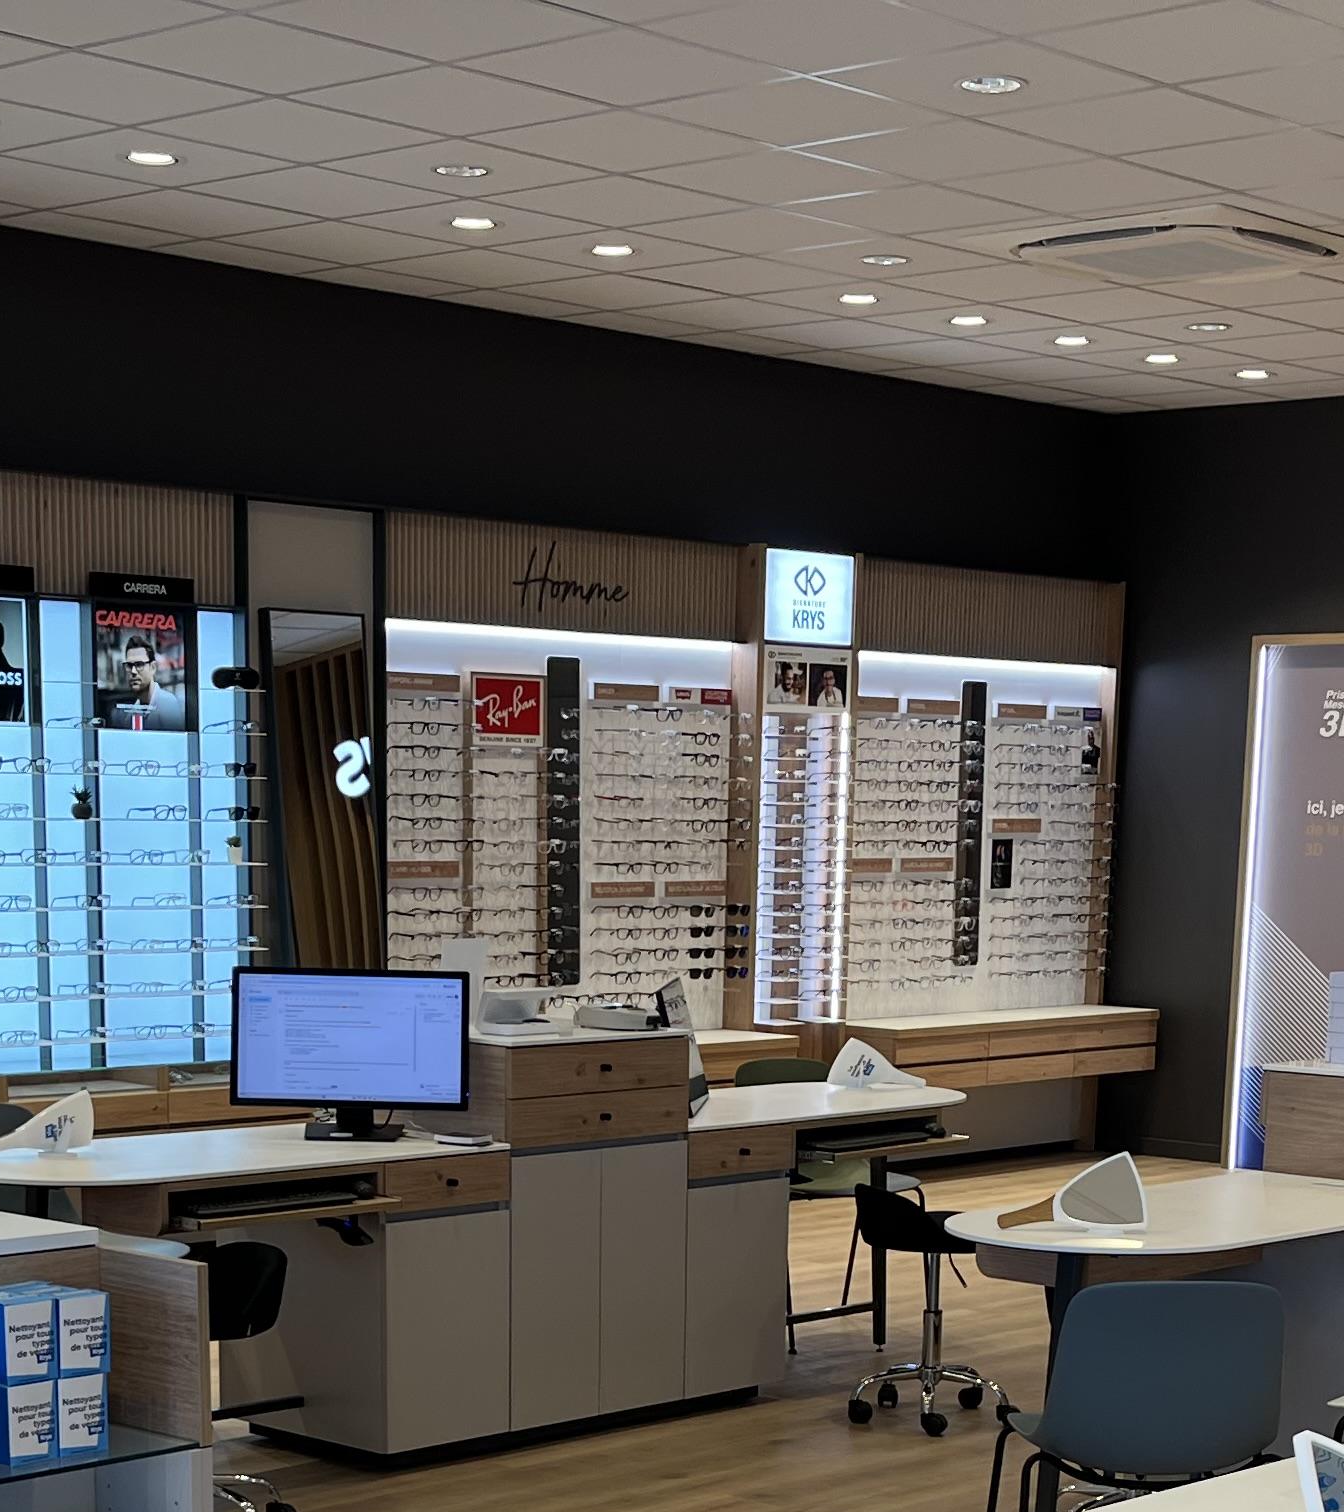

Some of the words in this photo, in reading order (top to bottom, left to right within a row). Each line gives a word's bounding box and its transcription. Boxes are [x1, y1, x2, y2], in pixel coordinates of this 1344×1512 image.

[512, 540, 630, 612] Homme
[123, 582, 167, 595] CARRERA
[95, 610, 177, 630] CARRERA
[792, 609, 825, 630] KRYS
[1306, 800, 1327, 816] ici,
[1330, 800, 1344, 818] je
[8, 1321, 50, 1333] Nettoyant
[63, 1315, 103, 1327] Nettoyant
[69, 1327, 88, 1336] pour
[16, 1333, 34, 1343] pour
[70, 1343, 81, 1351] de
[17, 1350, 28, 1358] de
[62, 1394, 101, 1406] Nettoyant
[11, 1401, 51, 1414] Nettoyant
[68, 1406, 87, 1416] pour
[17, 1413, 36, 1424] pour
[69, 1422, 79, 1430] de
[19, 1431, 29, 1439] de
